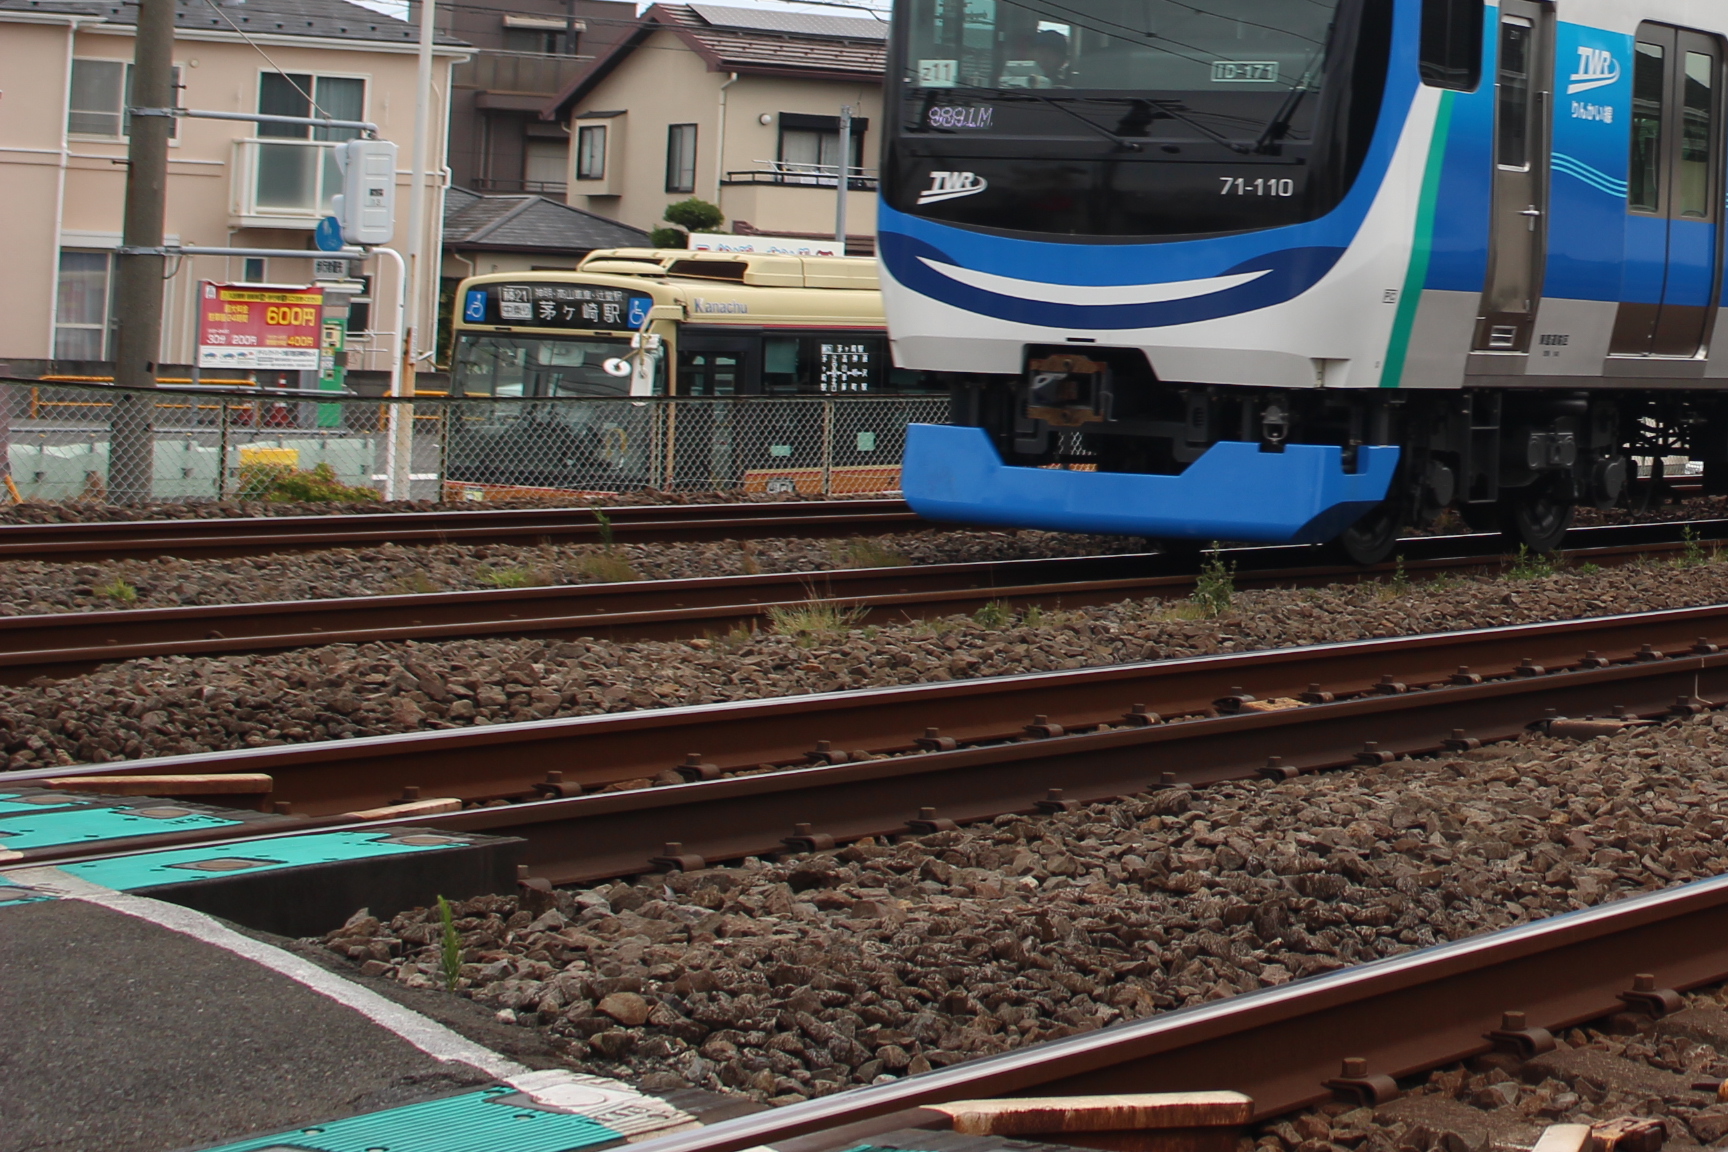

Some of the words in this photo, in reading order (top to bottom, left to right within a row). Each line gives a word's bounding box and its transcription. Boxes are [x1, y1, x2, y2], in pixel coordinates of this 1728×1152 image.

[1571, 100, 1613, 124] りんかい線
[1219, 177, 1294, 197] 71-110
[539, 301, 621, 324] 茅ヶ崎駅
[694, 298, 748, 314] Kanachu
[266, 307, 315, 326] 600円
